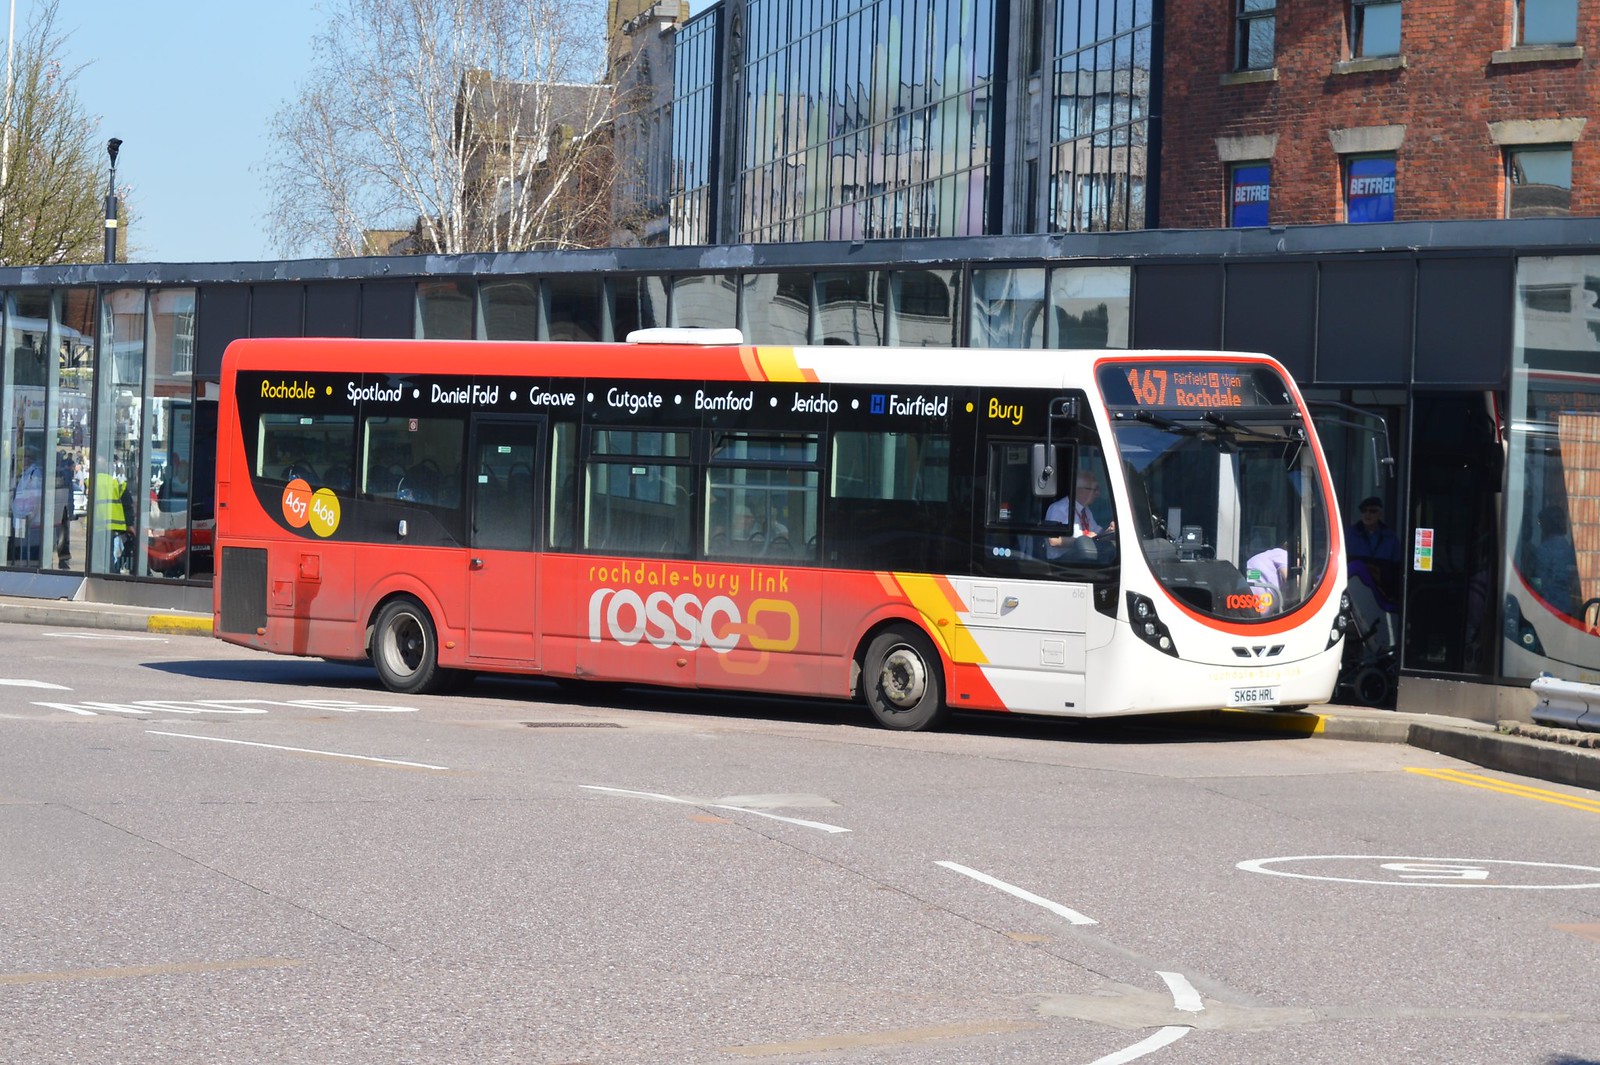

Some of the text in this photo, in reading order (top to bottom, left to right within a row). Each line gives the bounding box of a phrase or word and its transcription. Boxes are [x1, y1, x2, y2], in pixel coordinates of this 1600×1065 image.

[261, 380, 315, 399] Rochdale
[1173, 372, 1208, 385] Fairfield
[1221, 373, 1241, 387] then
[346, 381, 402, 406] Spotland
[431, 384, 499, 404] Daniel Fold
[529, 386, 575, 405] Greave
[607, 387, 662, 414] Cutgate
[695, 390, 753, 411] Bamford
[791, 392, 838, 413] Jericho
[1176, 388, 1241, 407] Rochdale
[889, 394, 949, 417] Fairfield
[988, 398, 1023, 425] Bury
[285, 491, 307, 518] 467
[313, 499, 334, 527] 468
[589, 561, 789, 596] rochdale-bury link
[1234, 689, 1275, 702] SK66 HRL
